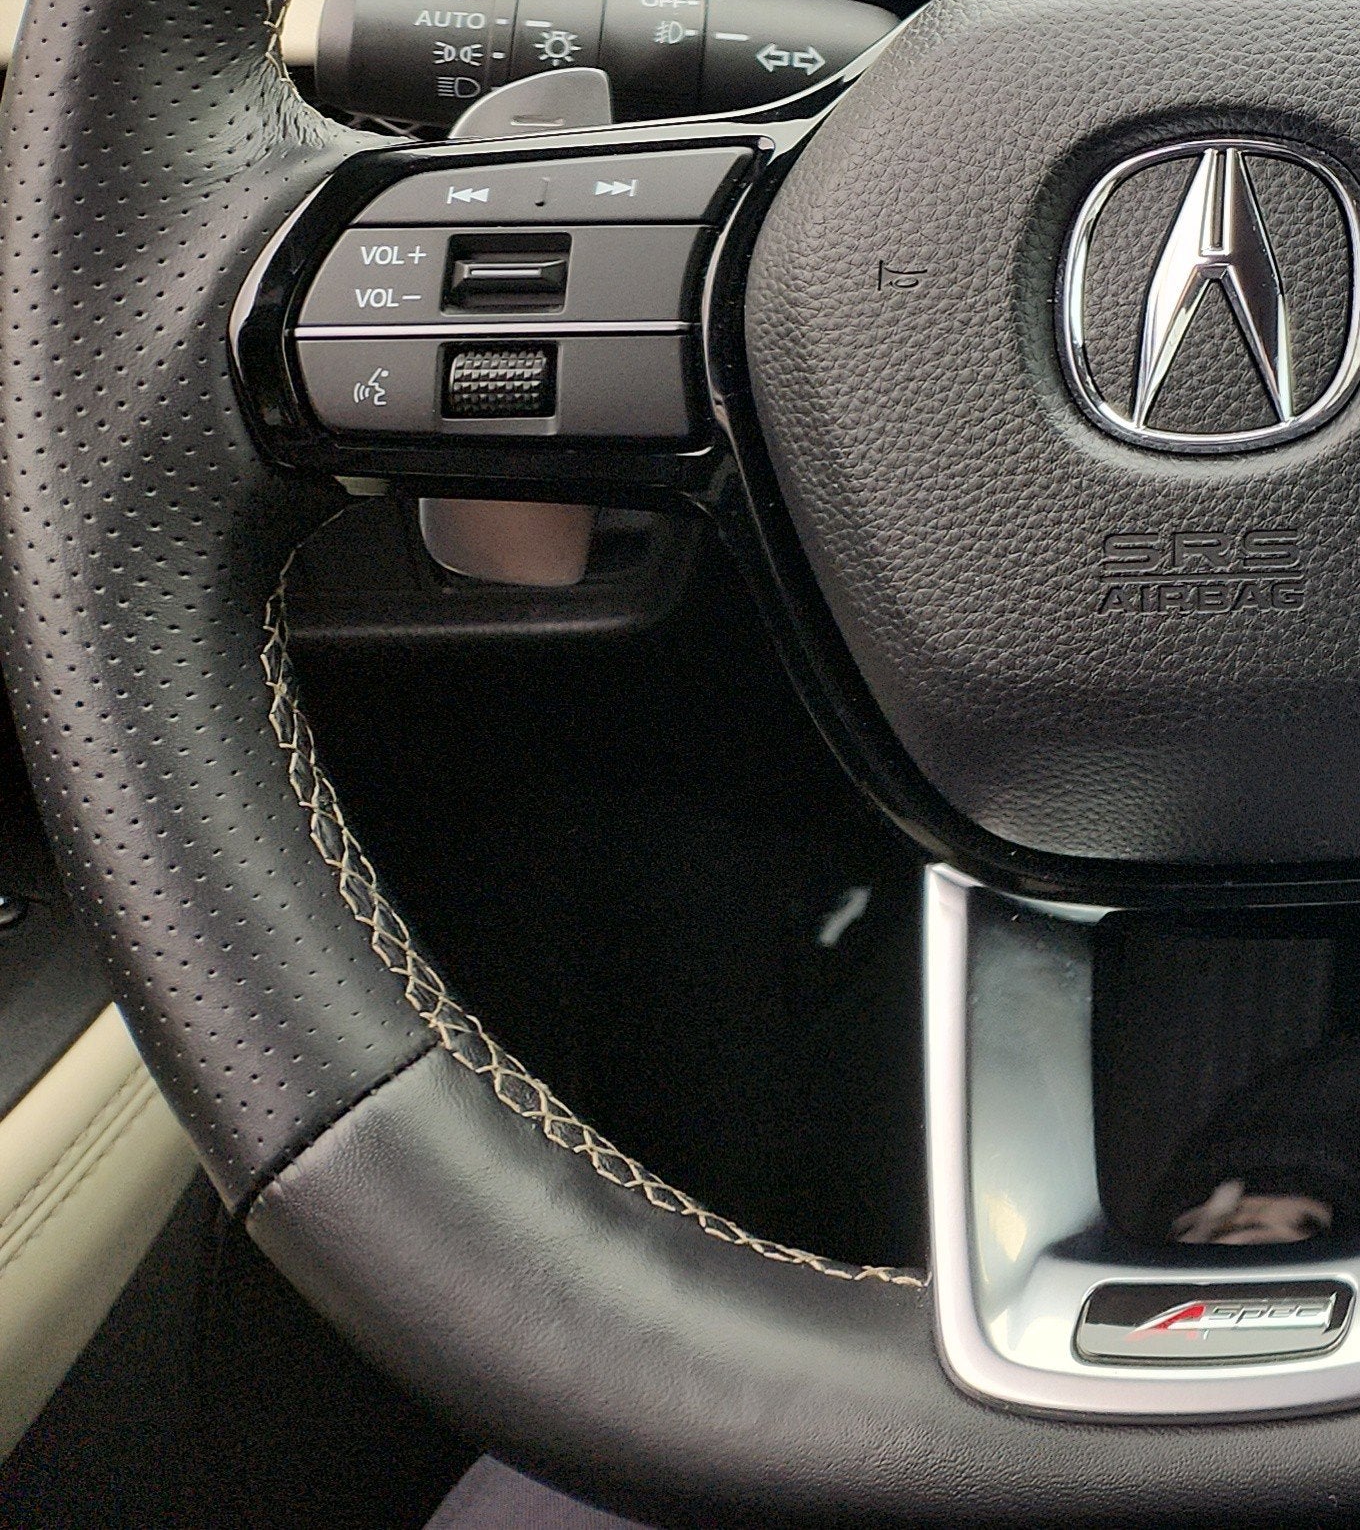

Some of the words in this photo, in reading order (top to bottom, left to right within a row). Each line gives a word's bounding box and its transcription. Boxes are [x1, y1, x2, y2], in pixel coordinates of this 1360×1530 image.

[414, 10, 487, 29] AUTO
[1101, 530, 1303, 572] SRS
[1099, 582, 1306, 616] AIRBAG
